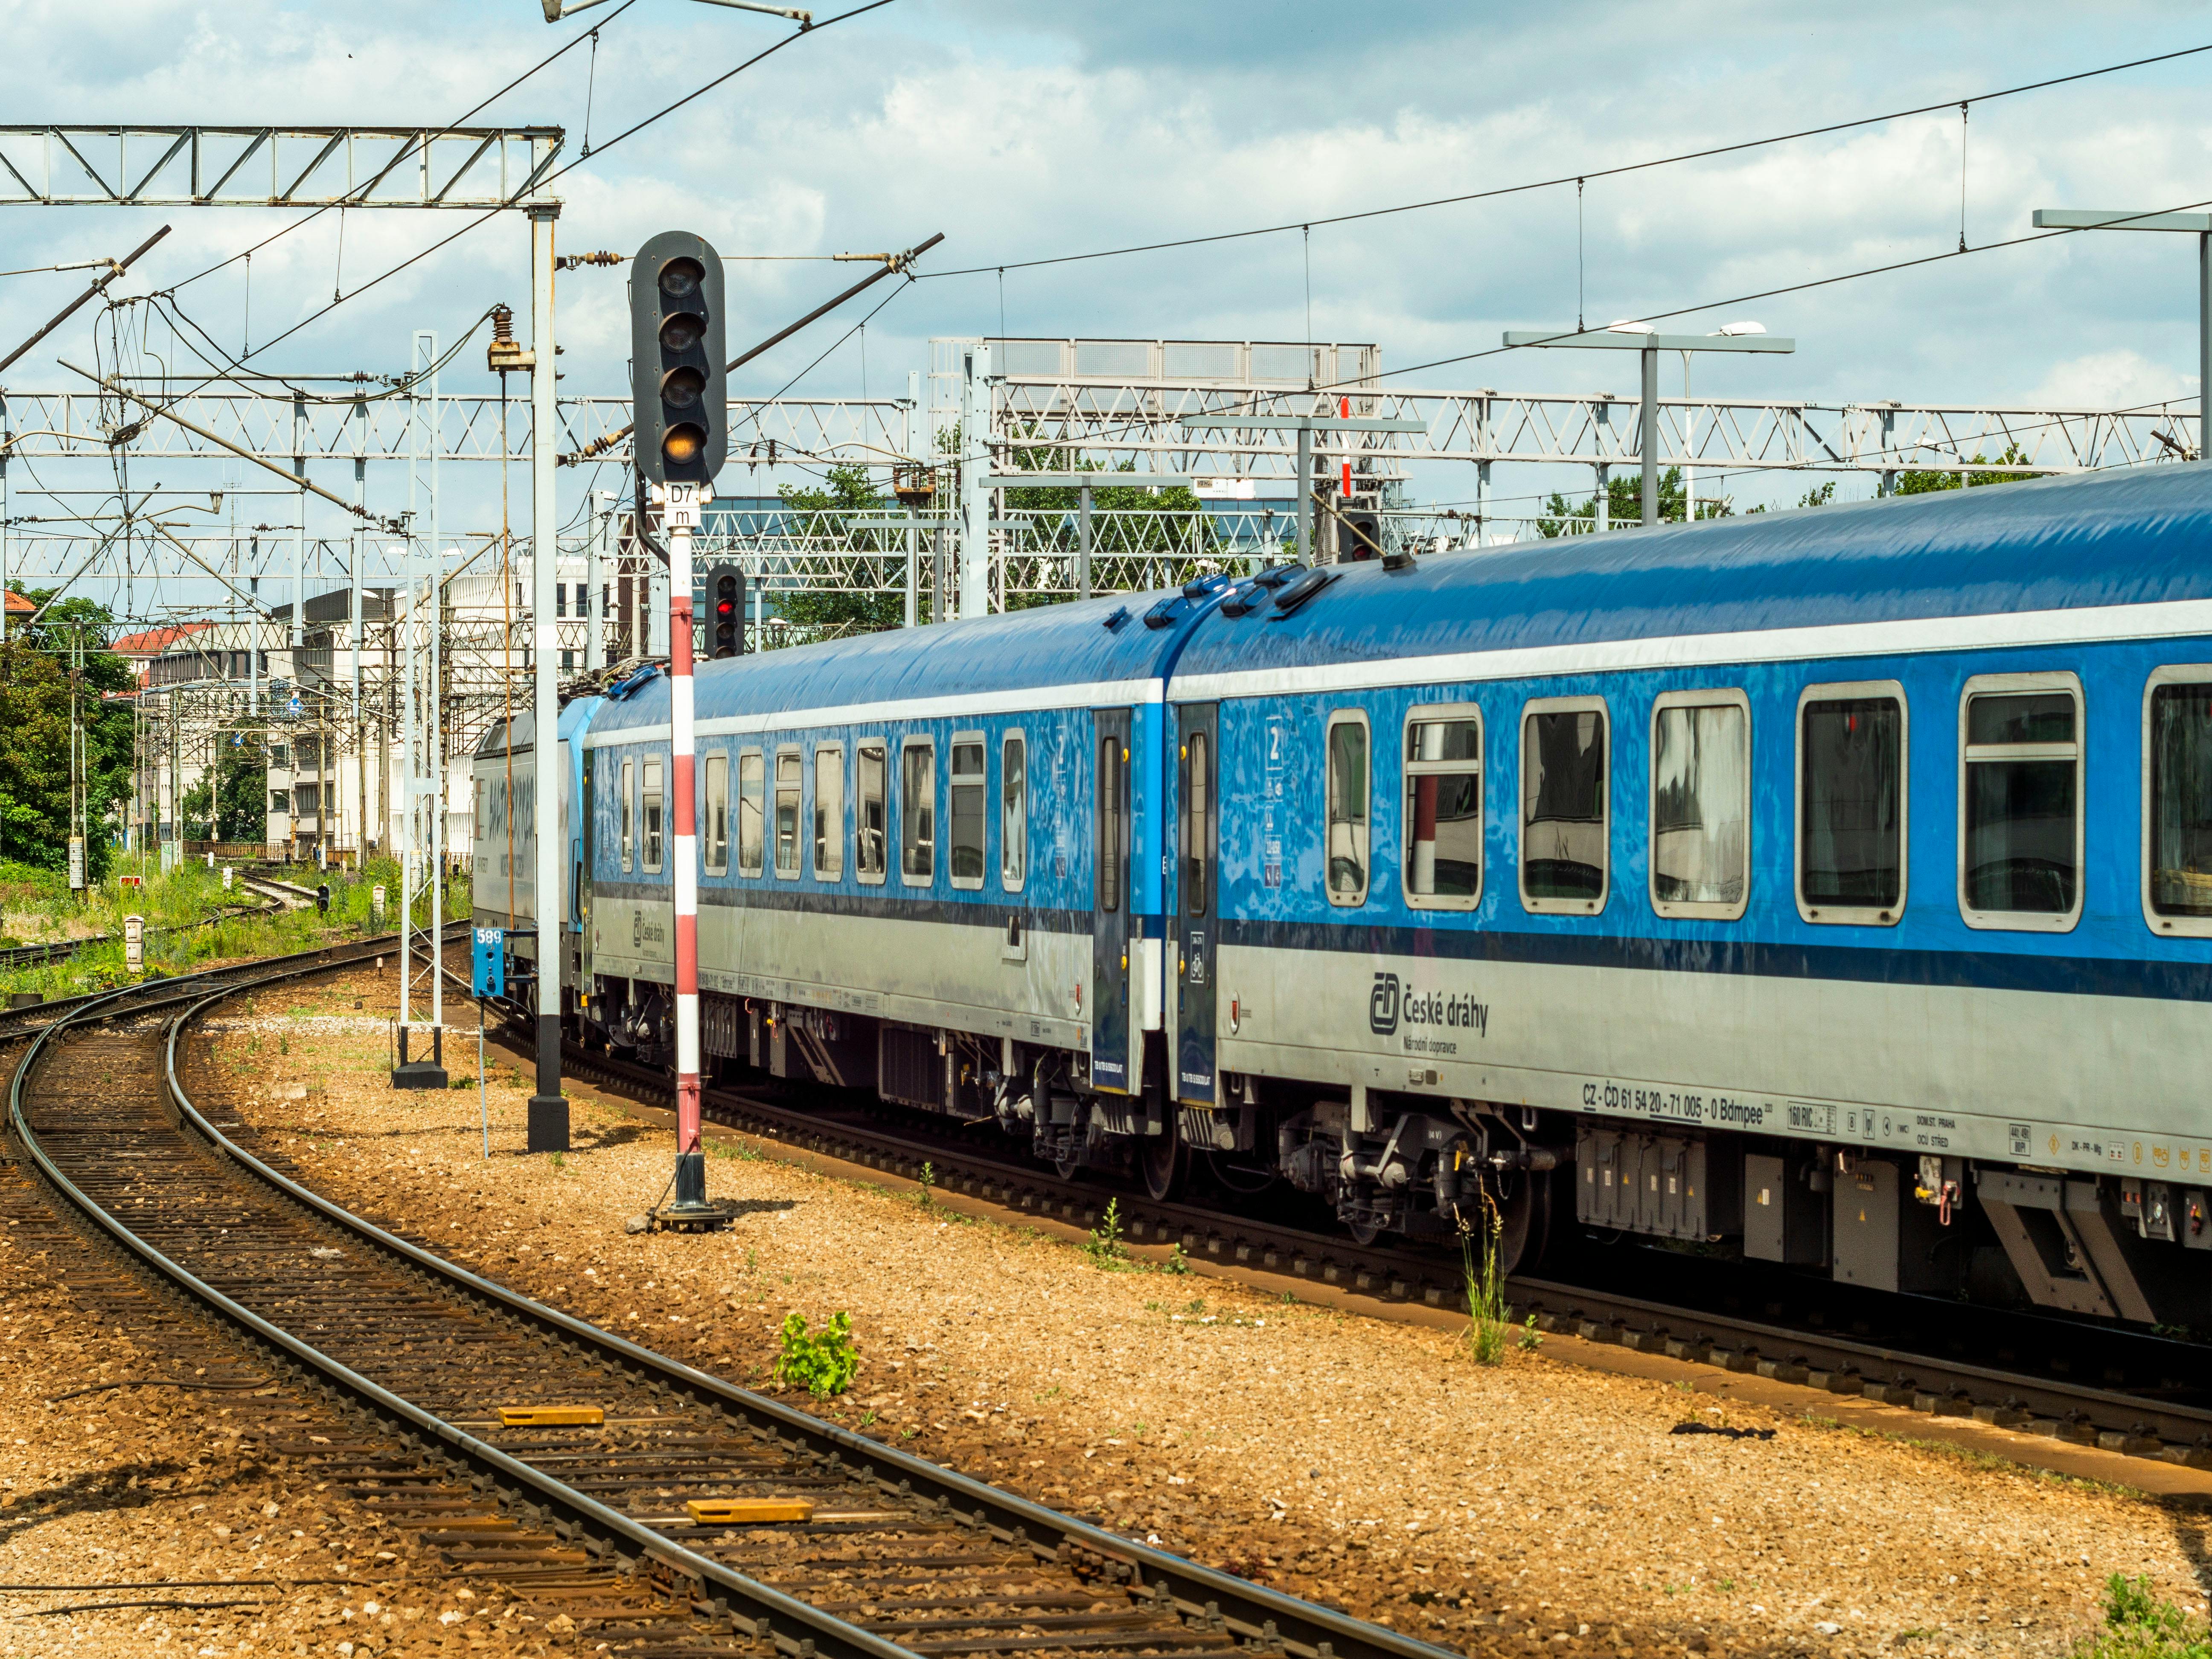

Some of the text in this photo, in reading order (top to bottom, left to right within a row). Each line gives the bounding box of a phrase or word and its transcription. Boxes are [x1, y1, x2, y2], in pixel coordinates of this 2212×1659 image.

[671, 485, 693, 503] D7
[676, 511, 689, 524] m
[1270, 726, 1279, 760] 2
[477, 929, 501, 944] 589
[1404, 984, 1489, 1038] České dráhy
[1404, 1035, 1457, 1056] Národní dopravce
[1583, 1083, 1596, 1105] CZ
[1604, 1080, 1619, 1107] ČD
[1621, 1089, 1632, 1109] 61
[1635, 1090, 1647, 1111] 54
[1649, 1091, 1661, 1113] 20
[1670, 1094, 1681, 1115] 71
[1684, 1095, 1702, 1118] 005
[1711, 1098, 1717, 1120] 0
[1720, 1098, 1763, 1129] Bdmpee
[1789, 1106, 1800, 1126] 160
[1802, 1107, 1813, 1128] RIC
[1938, 1118, 1956, 1129] PRAHA
